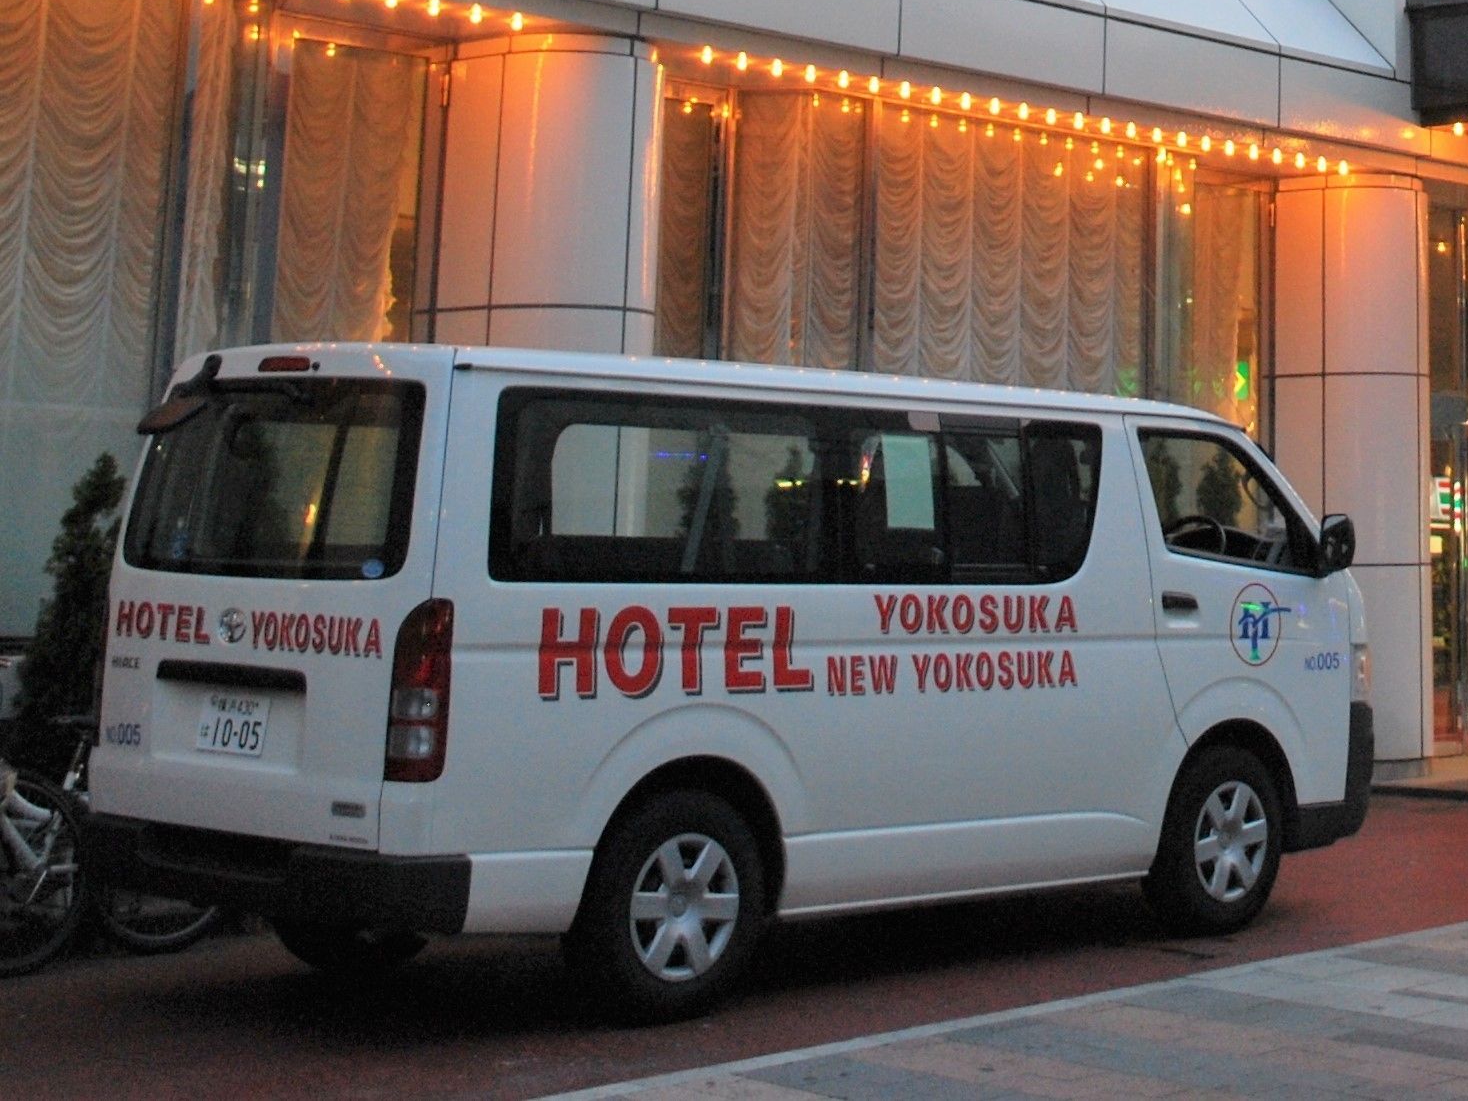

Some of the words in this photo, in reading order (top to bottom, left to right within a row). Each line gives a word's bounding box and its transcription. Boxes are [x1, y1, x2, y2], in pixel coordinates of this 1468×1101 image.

[116, 600, 211, 645] HOTEL
[251, 610, 383, 660] YOKOSUKA
[874, 593, 1079, 634] YOKOSUKA
[538, 605, 813, 700] HOTEL
[826, 654, 899, 697] NEW
[914, 650, 1079, 693] YOKOSUKA
